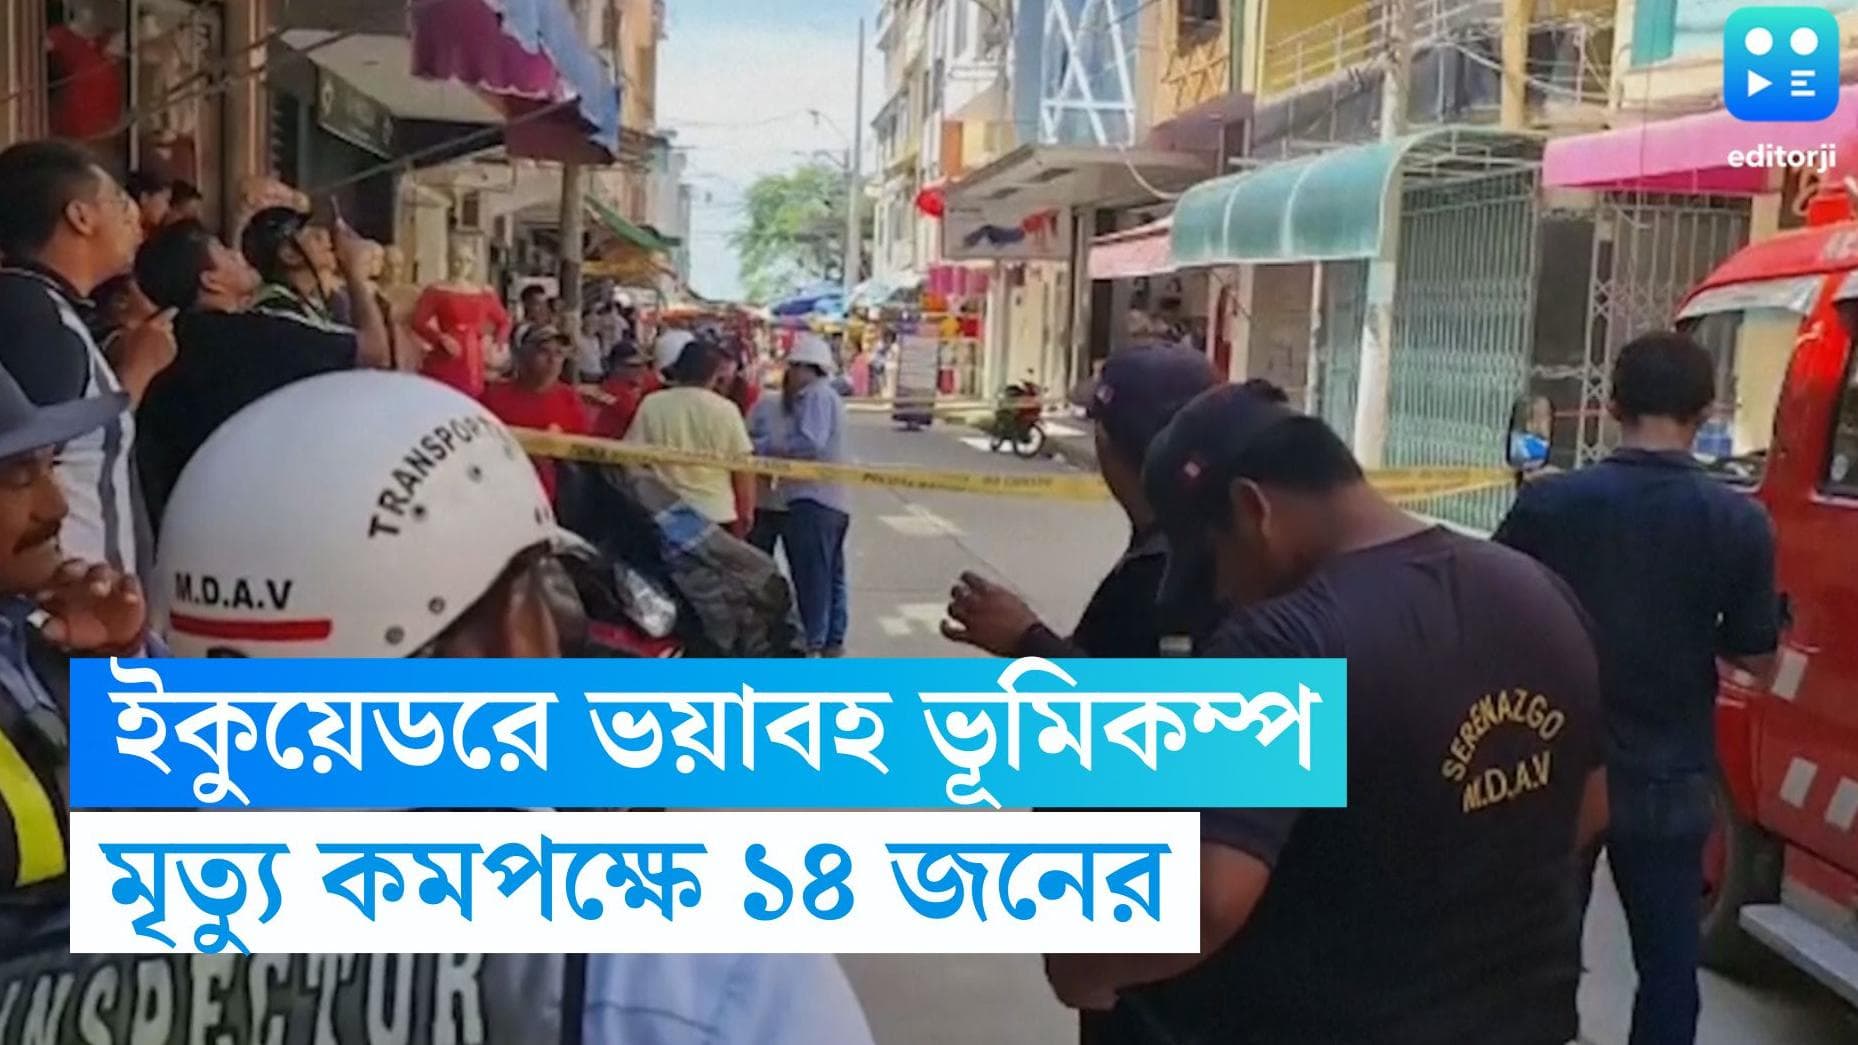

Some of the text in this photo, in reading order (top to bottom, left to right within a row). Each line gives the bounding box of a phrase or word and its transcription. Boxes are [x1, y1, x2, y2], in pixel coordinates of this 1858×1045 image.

[175, 572, 293, 611] M.D.A.V
[1441, 687, 1566, 782] SERENAZGO
[1463, 751, 1551, 813] M.D.A.V
